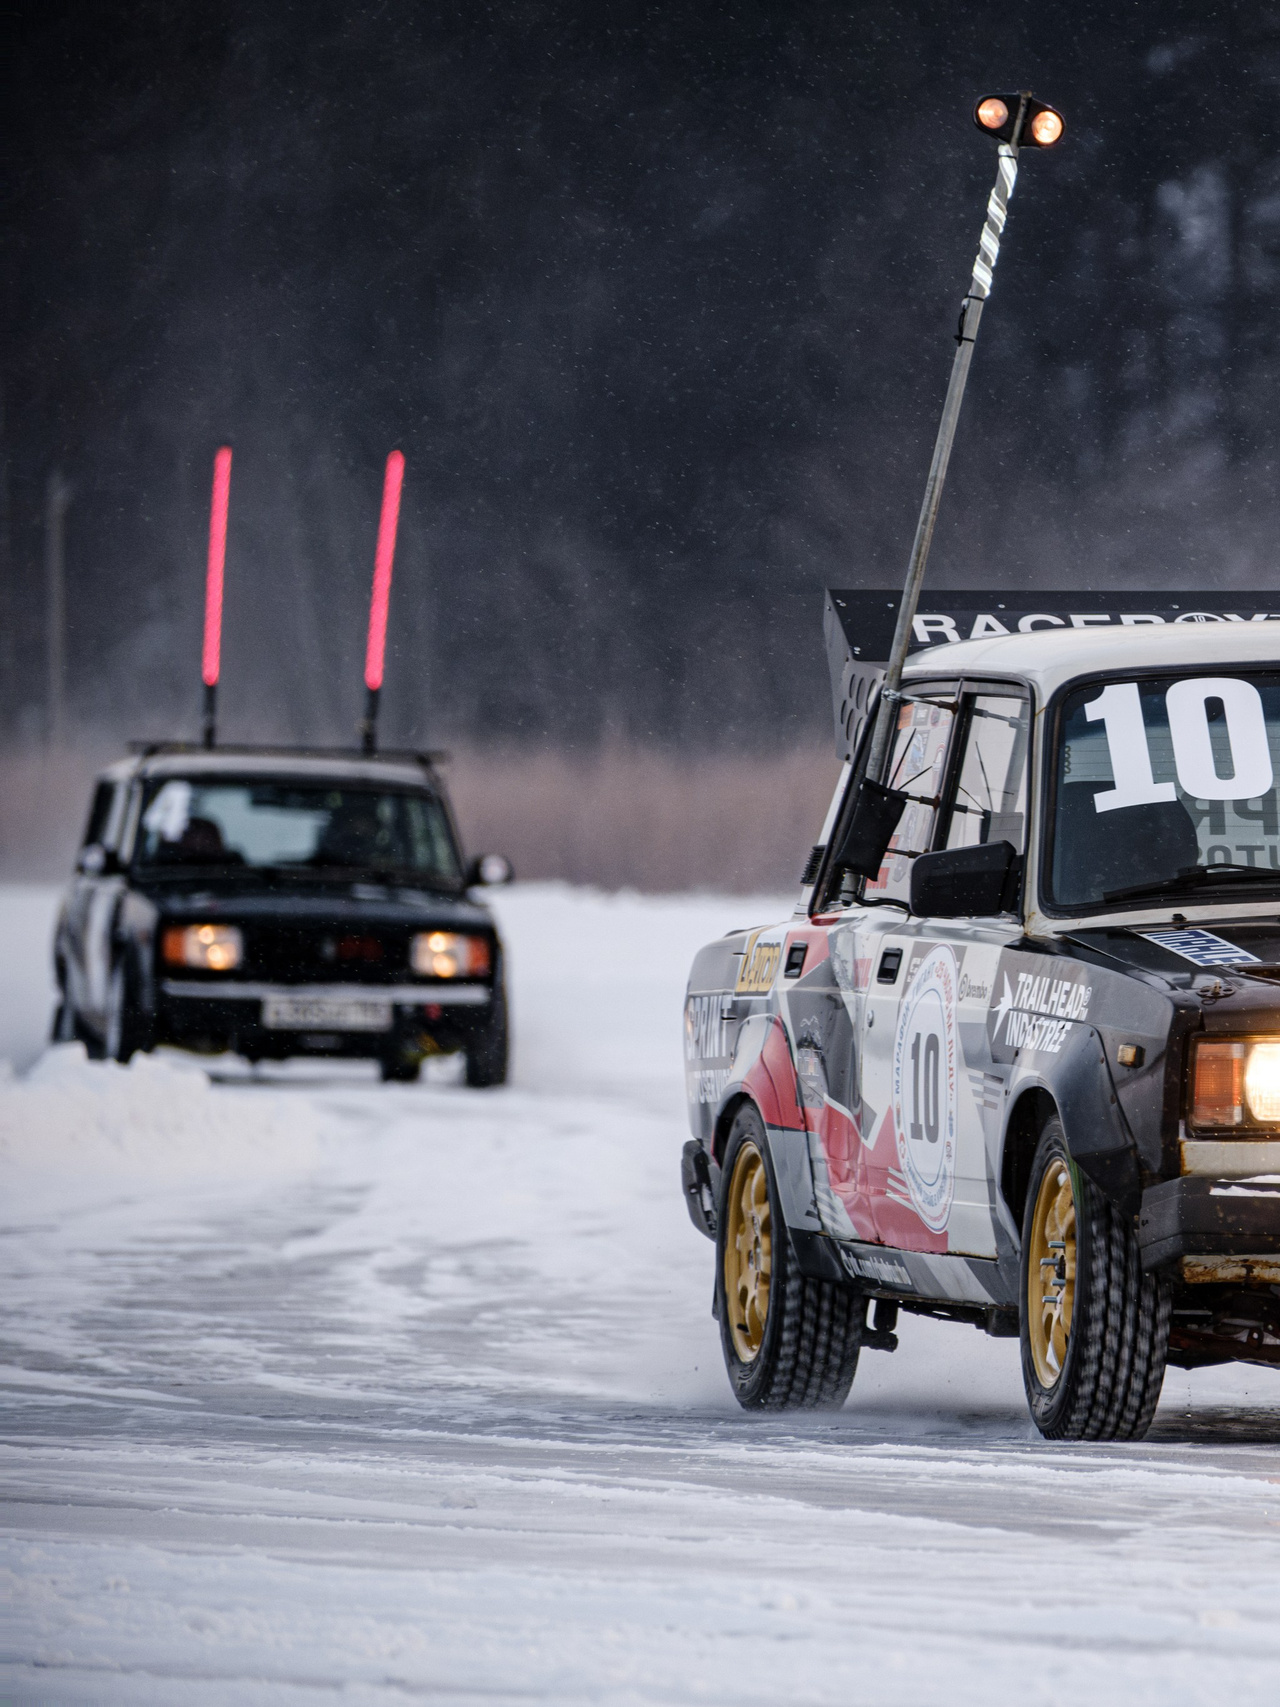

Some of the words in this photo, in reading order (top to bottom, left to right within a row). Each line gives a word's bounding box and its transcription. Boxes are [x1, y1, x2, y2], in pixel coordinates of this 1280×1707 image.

[1084, 677, 1274, 813] 10
[1013, 972, 1086, 1020] TRAILHEAD
[910, 1032, 940, 1143] 10
